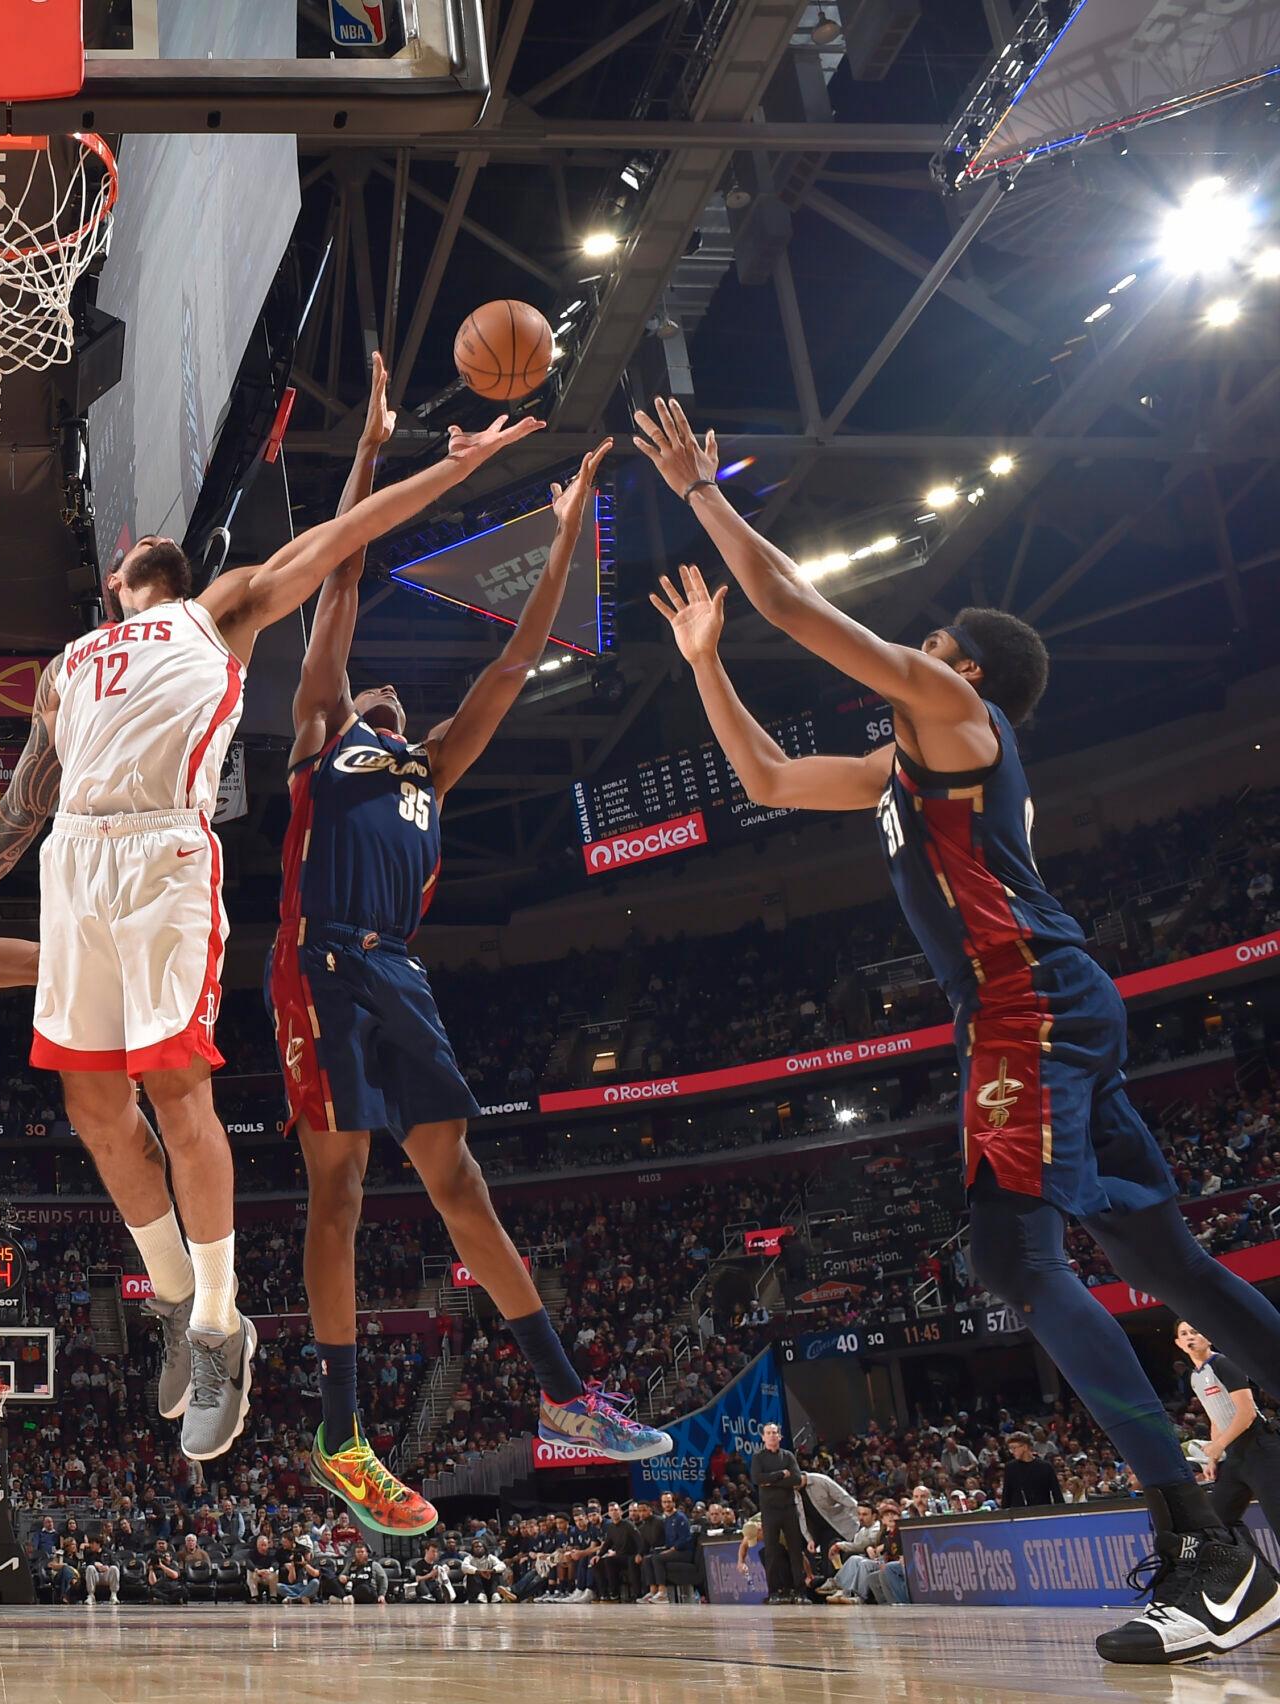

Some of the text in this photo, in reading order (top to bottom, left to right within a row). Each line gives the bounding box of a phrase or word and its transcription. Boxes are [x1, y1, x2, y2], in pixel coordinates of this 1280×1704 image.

[340, 25, 365, 39] NBA
[474, 557, 522, 588] LET
[94, 652, 128, 701] 12
[399, 781, 431, 831] 35
[574, 782, 593, 843] CAVALIERS
[607, 811, 638, 824] MITCHELL
[612, 819, 699, 862] Rocket
[1236, 940, 1278, 961] Own
[785, 1037, 912, 1073] Own the Dream
[620, 1080, 680, 1101] Rocket
[480, 1099, 532, 1116] KNOW.
[24, 1123, 47, 1137] 3Q
[227, 1121, 264, 1133] FOULS
[960, 1318, 974, 1334] 24
[987, 1310, 1007, 1332] 57
[836, 1333, 858, 1353] 40
[867, 1332, 885, 1346] 3Q
[903, 1323, 941, 1344] 11:45
[722, 1416, 746, 1435] Full
[640, 1457, 705, 1469] COMCAST
[642, 1469, 706, 1481] BUSINESS
[1023, 1537, 1099, 1590] STREAM
[1095, 1535, 1144, 1590] LIKE
